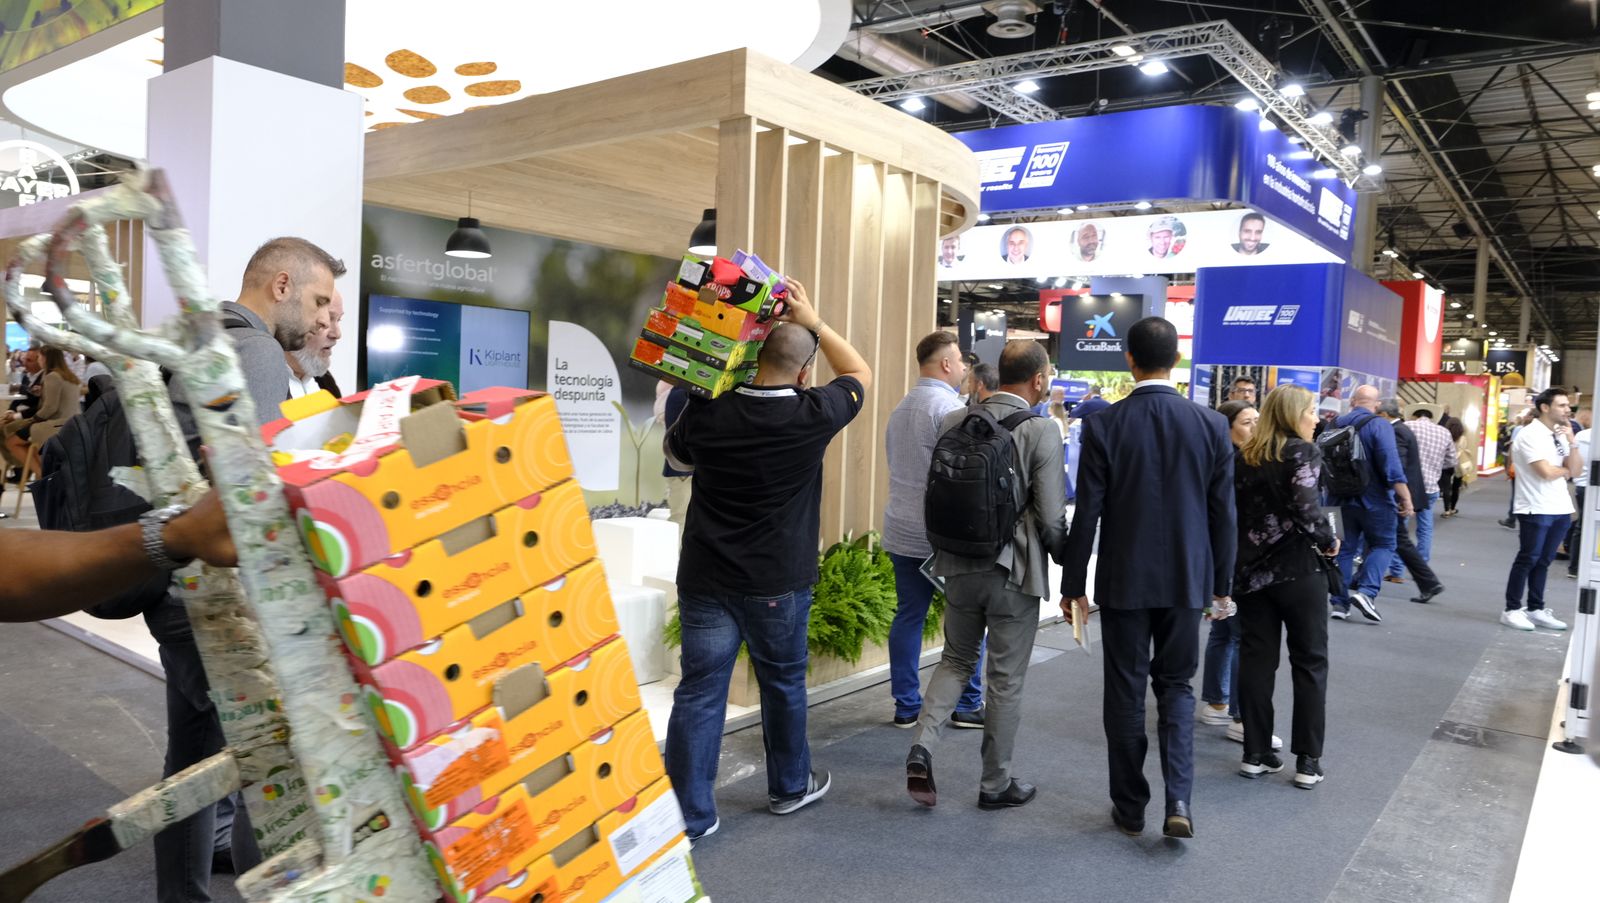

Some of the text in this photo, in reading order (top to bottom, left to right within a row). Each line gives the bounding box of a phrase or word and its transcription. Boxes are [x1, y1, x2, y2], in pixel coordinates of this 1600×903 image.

[974, 146, 1061, 184] TEC 100
[0, 176, 71, 201] AYER
[371, 253, 493, 282] asfertglobal
[412, 310, 439, 319] technology
[1223, 305, 1278, 321] UNITEC
[1076, 340, 1122, 352] CaixaBank
[485, 349, 521, 363] Kiplant
[555, 357, 569, 371] La
[1458, 360, 1492, 373] VS.
[1495, 361, 1520, 373] ES.
[554, 373, 613, 390] tecnología
[554, 387, 606, 404] despunta
